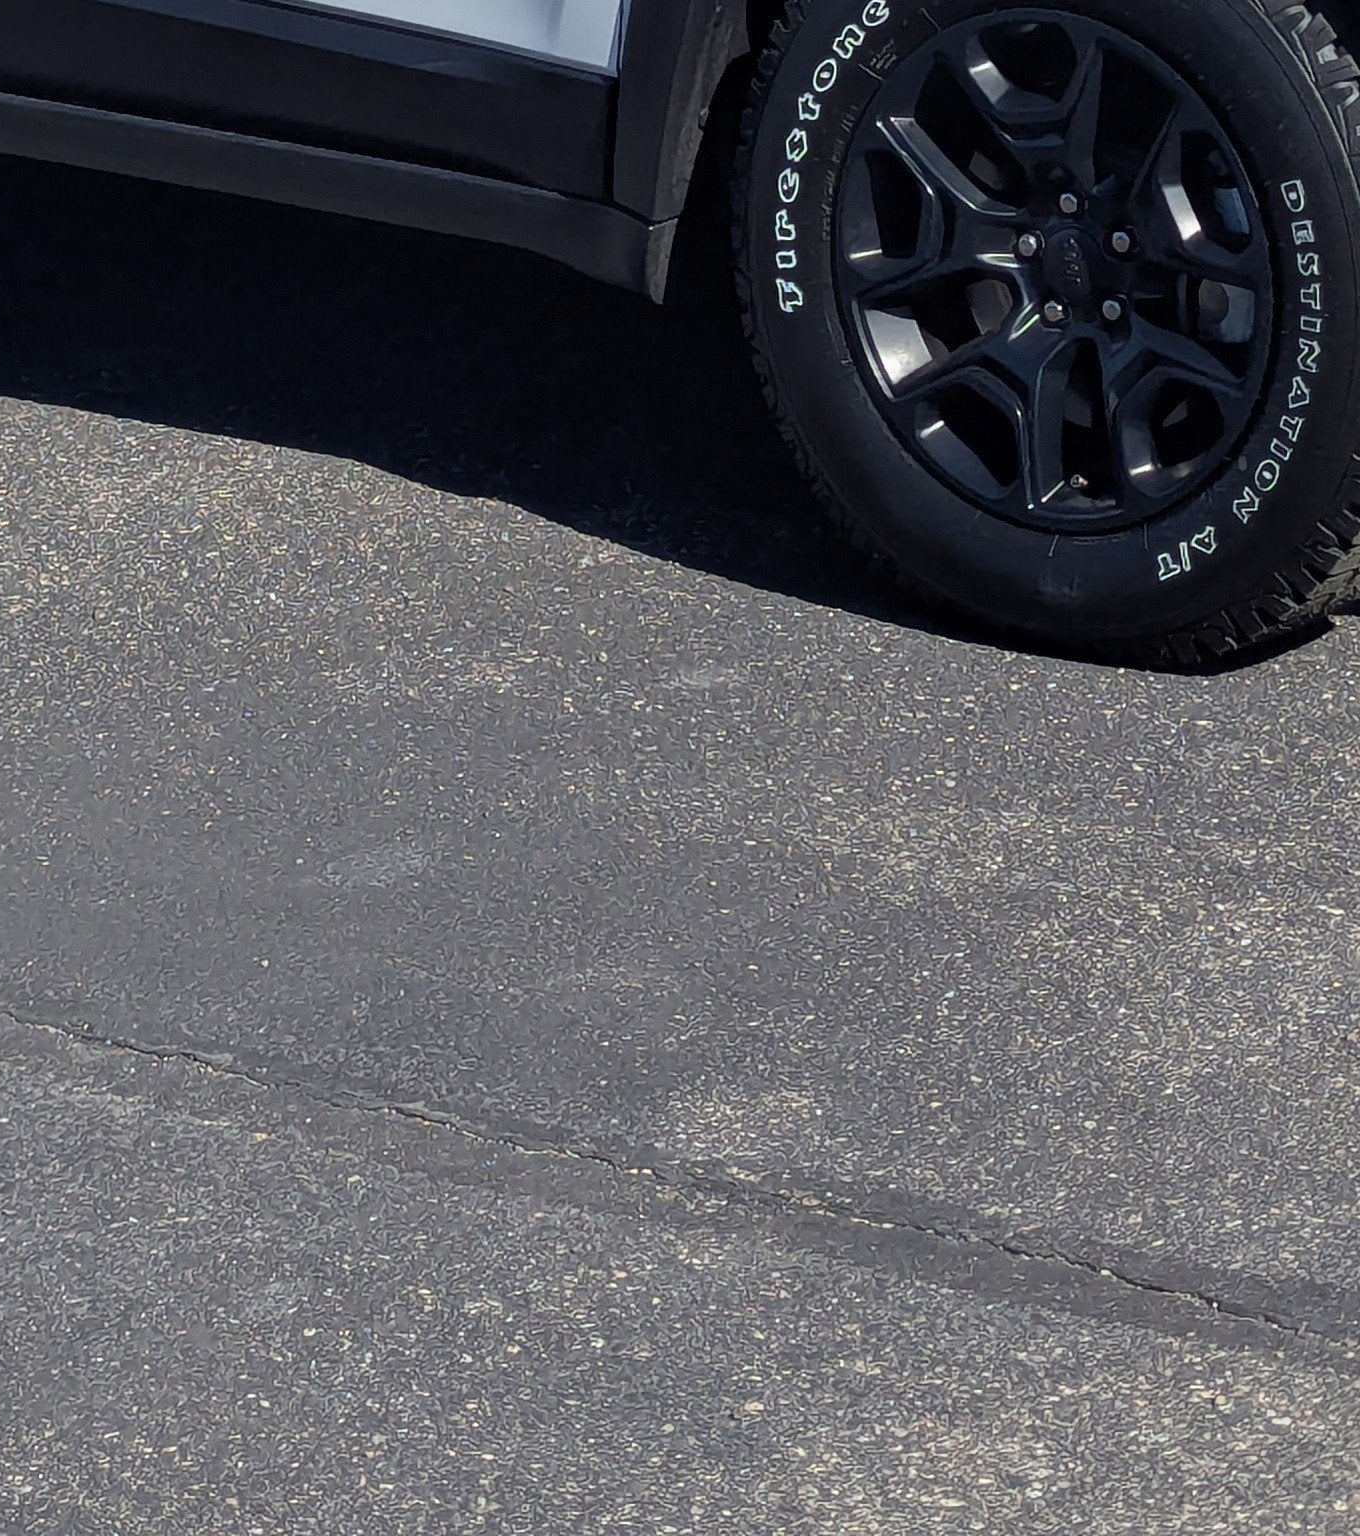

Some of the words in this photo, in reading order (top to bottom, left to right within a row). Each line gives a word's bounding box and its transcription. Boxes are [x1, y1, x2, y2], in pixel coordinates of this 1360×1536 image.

[775, 0, 890, 313] Firestone
[1232, 179, 1322, 525] DESTINATION
[1158, 526, 1217, 581] A/T
